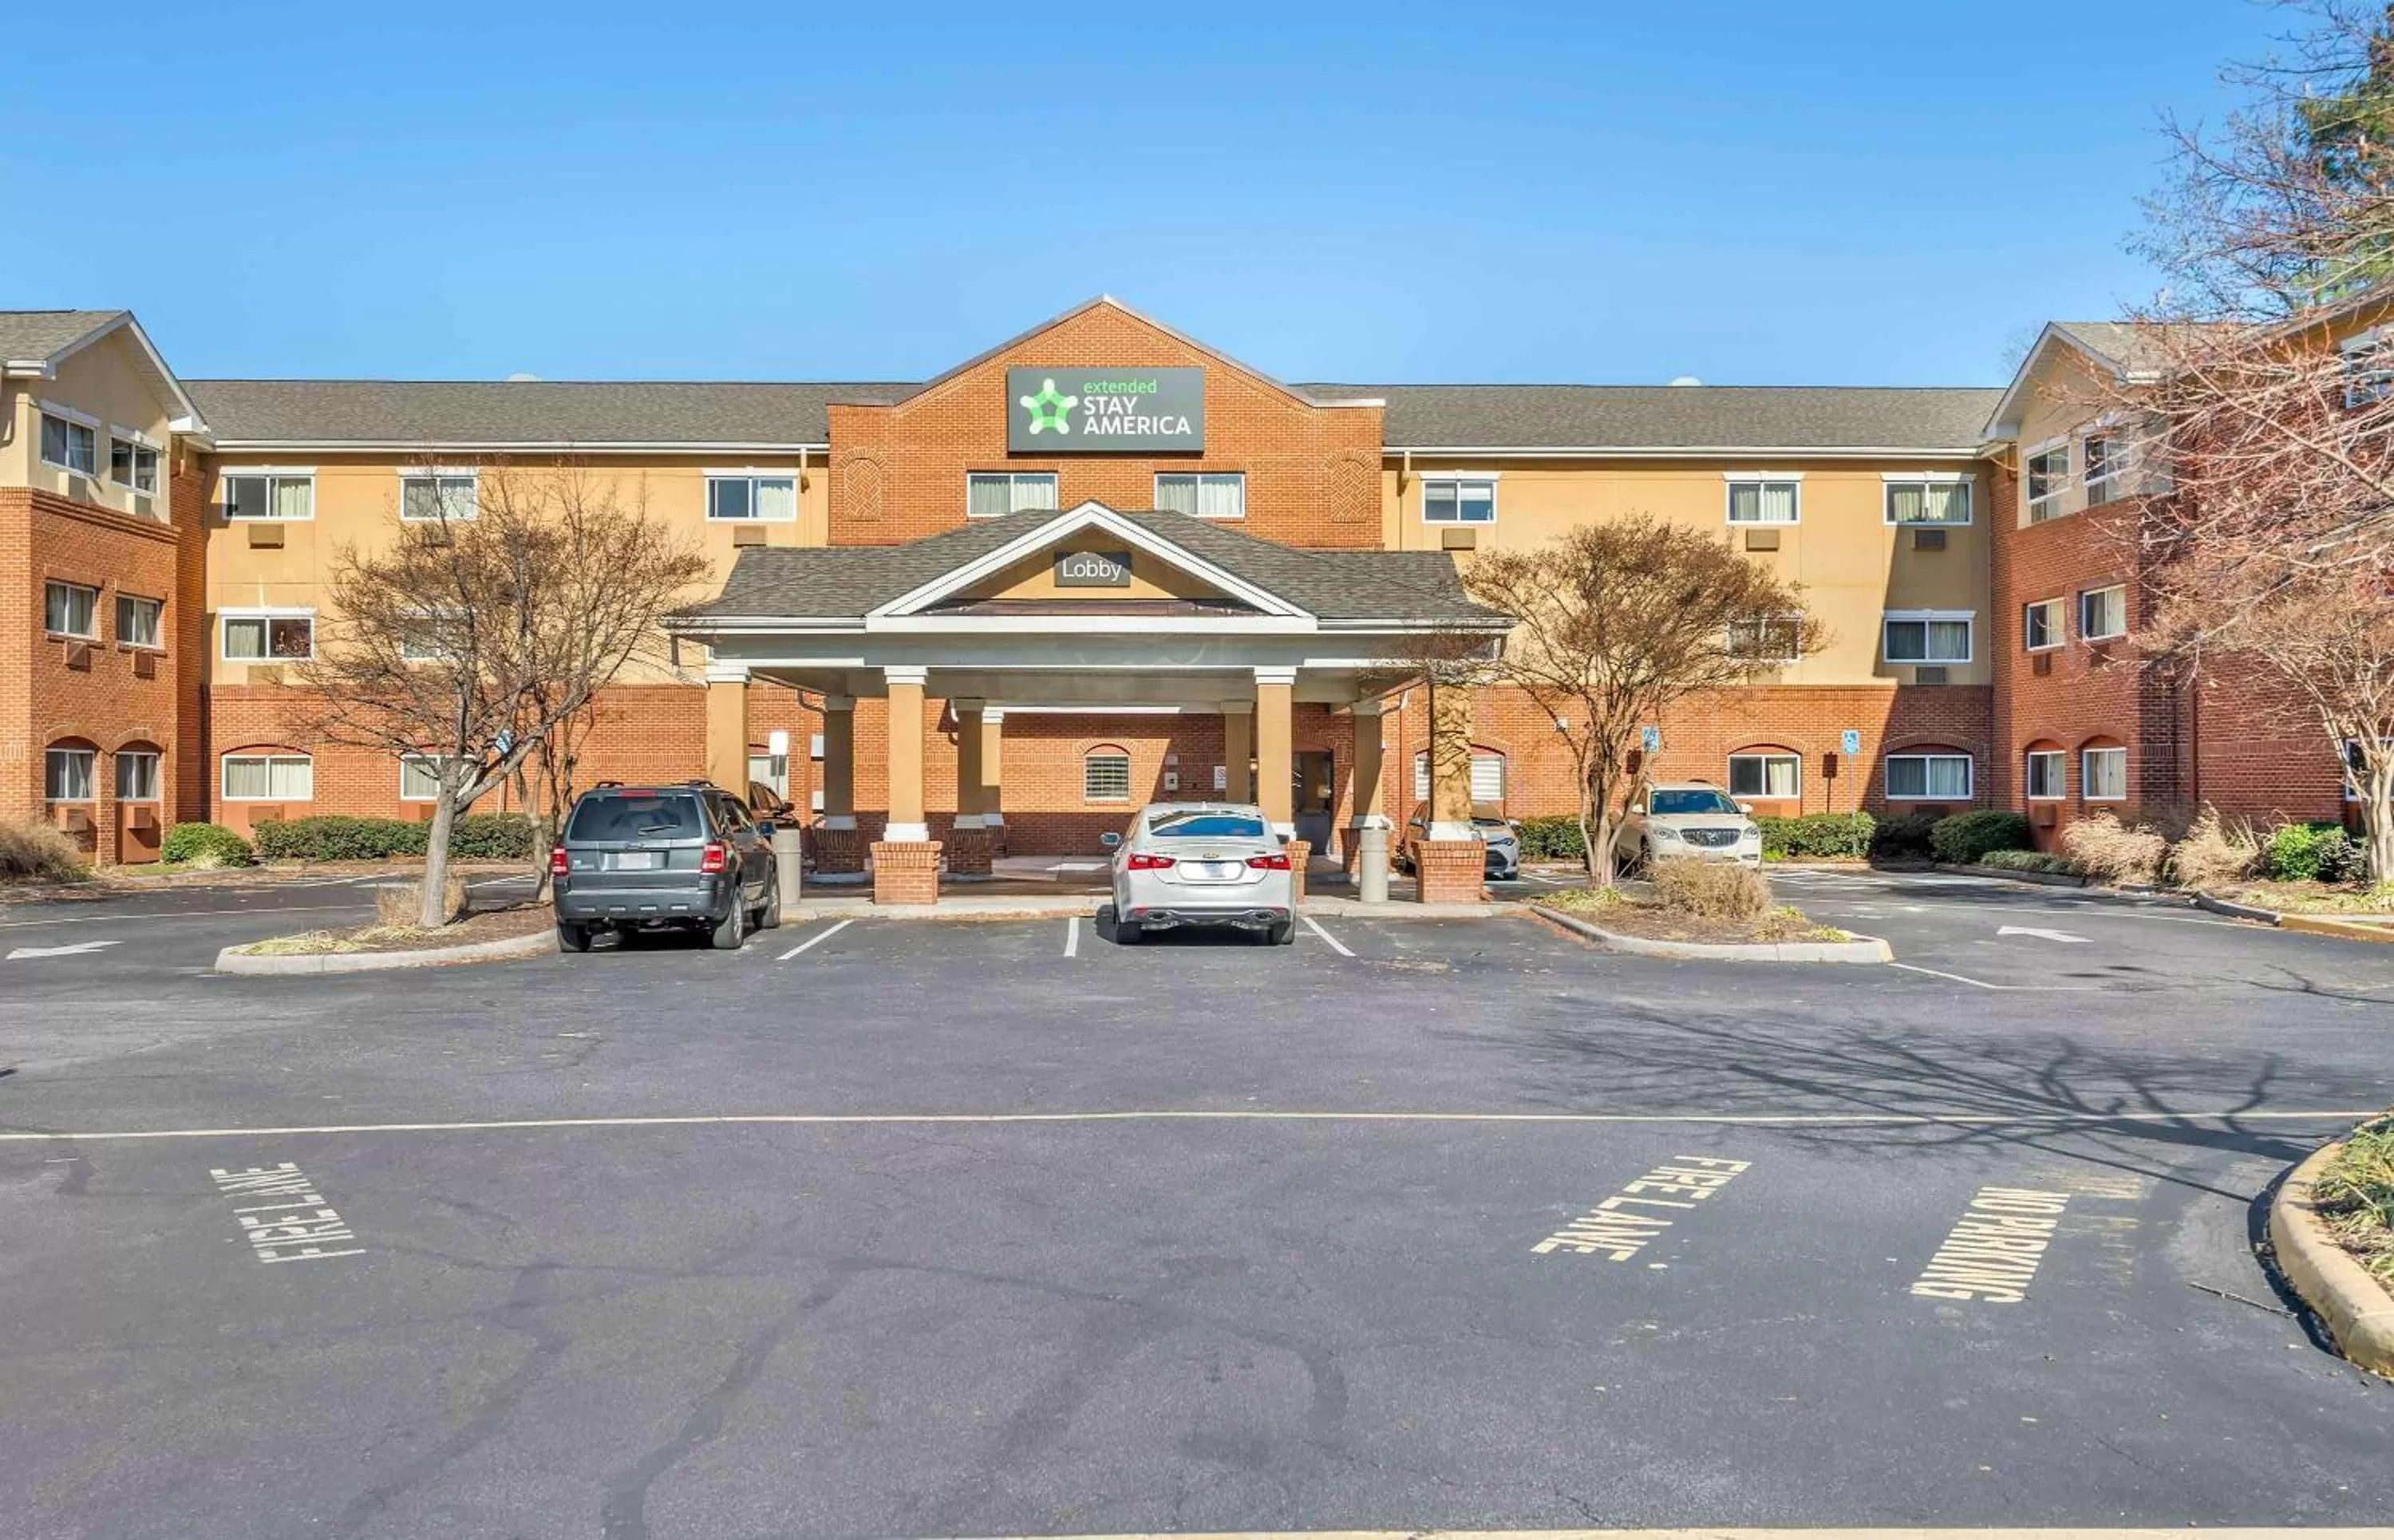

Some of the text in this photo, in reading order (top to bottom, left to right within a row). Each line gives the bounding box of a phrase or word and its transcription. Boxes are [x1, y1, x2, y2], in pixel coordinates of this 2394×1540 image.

[1083, 379, 1157, 393] extended
[1084, 397, 1138, 416] STAY
[1083, 417, 1191, 435] AMERICA
[1062, 561, 1123, 582] Lobby
[1529, 1155, 1752, 1262] FIRE LANE
[239, 1209, 367, 1263] FIRE
[1909, 1186, 2071, 1304] NO PARKING
